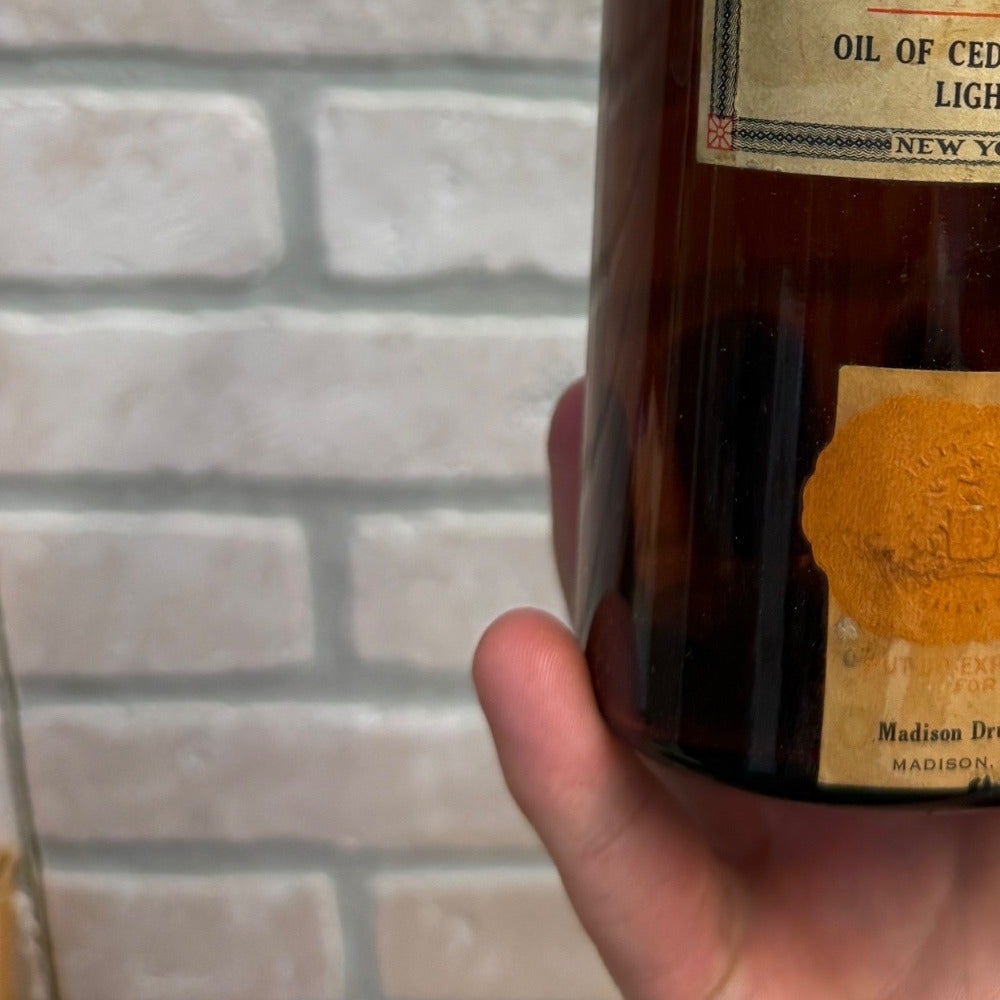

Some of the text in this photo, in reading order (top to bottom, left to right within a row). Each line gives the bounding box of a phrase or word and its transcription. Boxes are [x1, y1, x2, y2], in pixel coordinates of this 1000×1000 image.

[833, 33, 881, 63] OIL
[895, 37, 935, 65] OF
[894, 135, 971, 157] NEW
[952, 678, 997, 694] FOR
[878, 720, 963, 743] Madison
